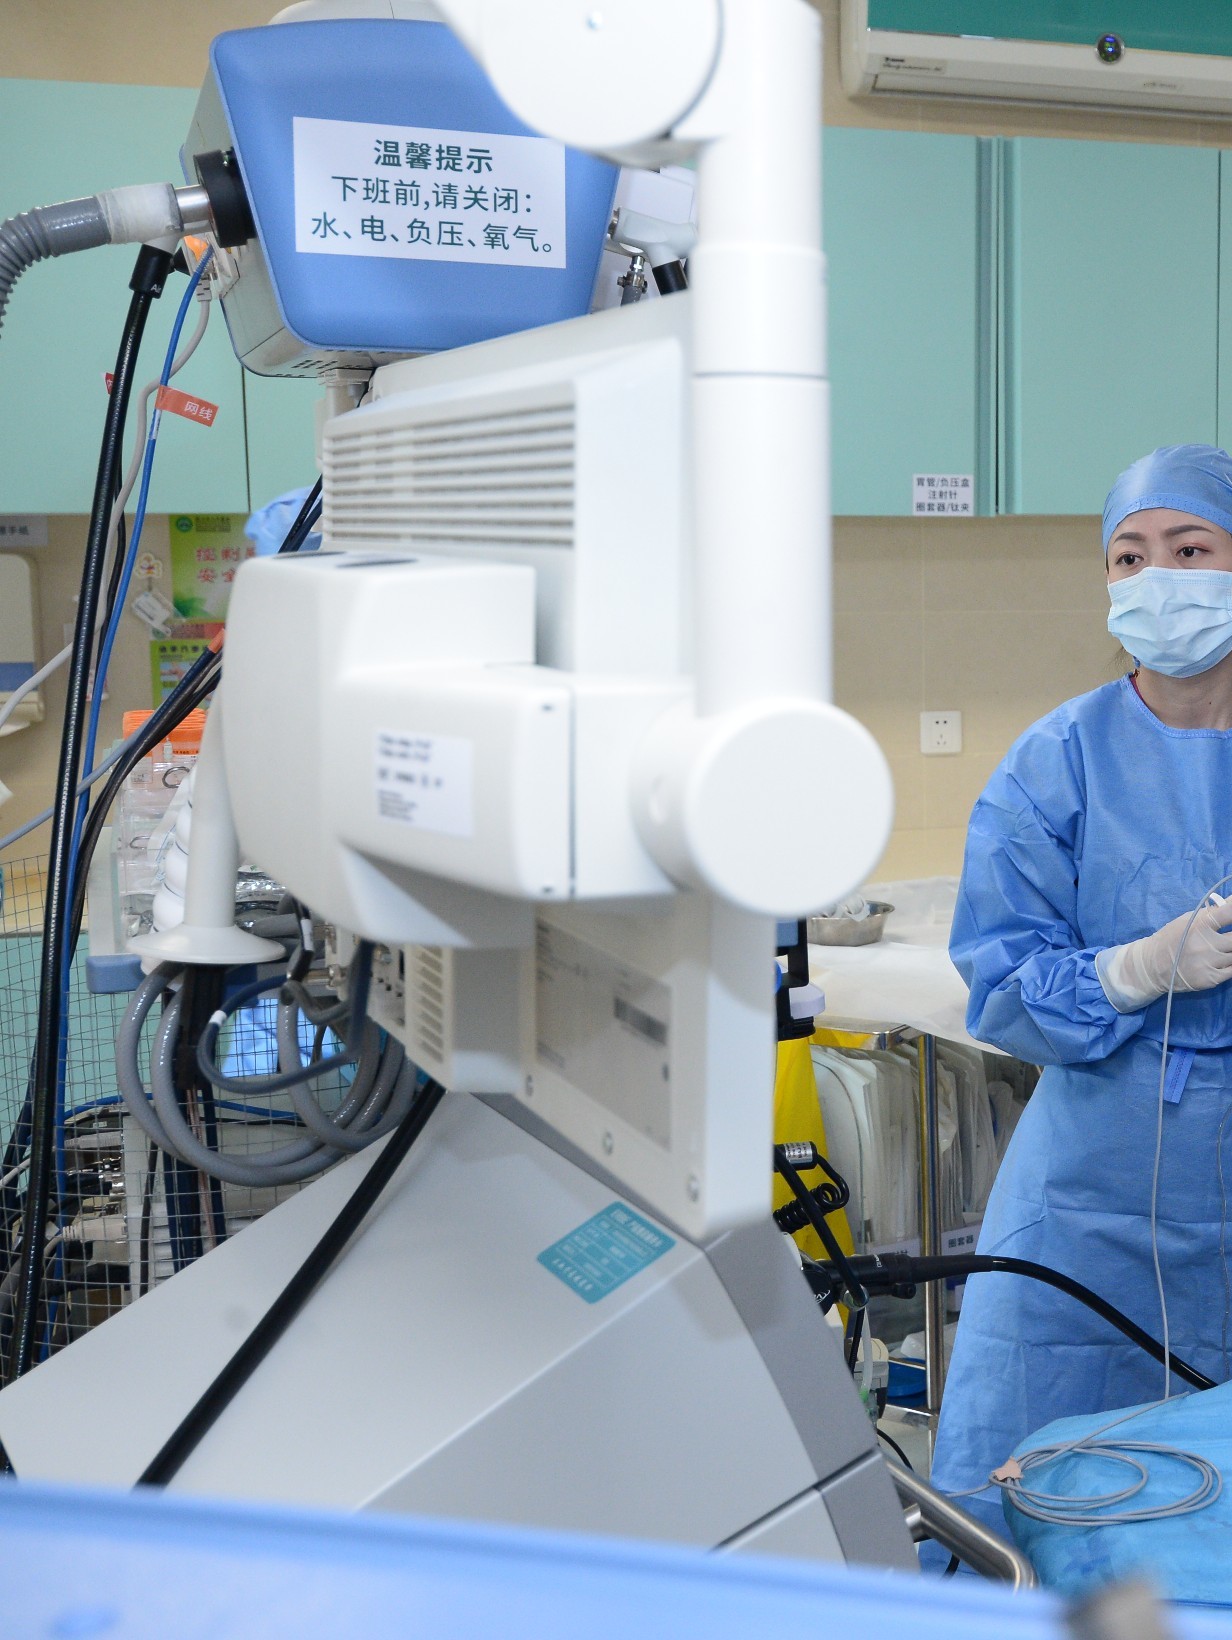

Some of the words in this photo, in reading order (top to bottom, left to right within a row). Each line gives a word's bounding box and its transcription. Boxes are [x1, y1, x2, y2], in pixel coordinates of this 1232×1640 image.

[374, 138, 494, 174] 温馨提示
[311, 211, 552, 253] 水、电、负压、氧气。
[183, 401, 213, 420] 网线
[927, 489, 958, 501] 注射针
